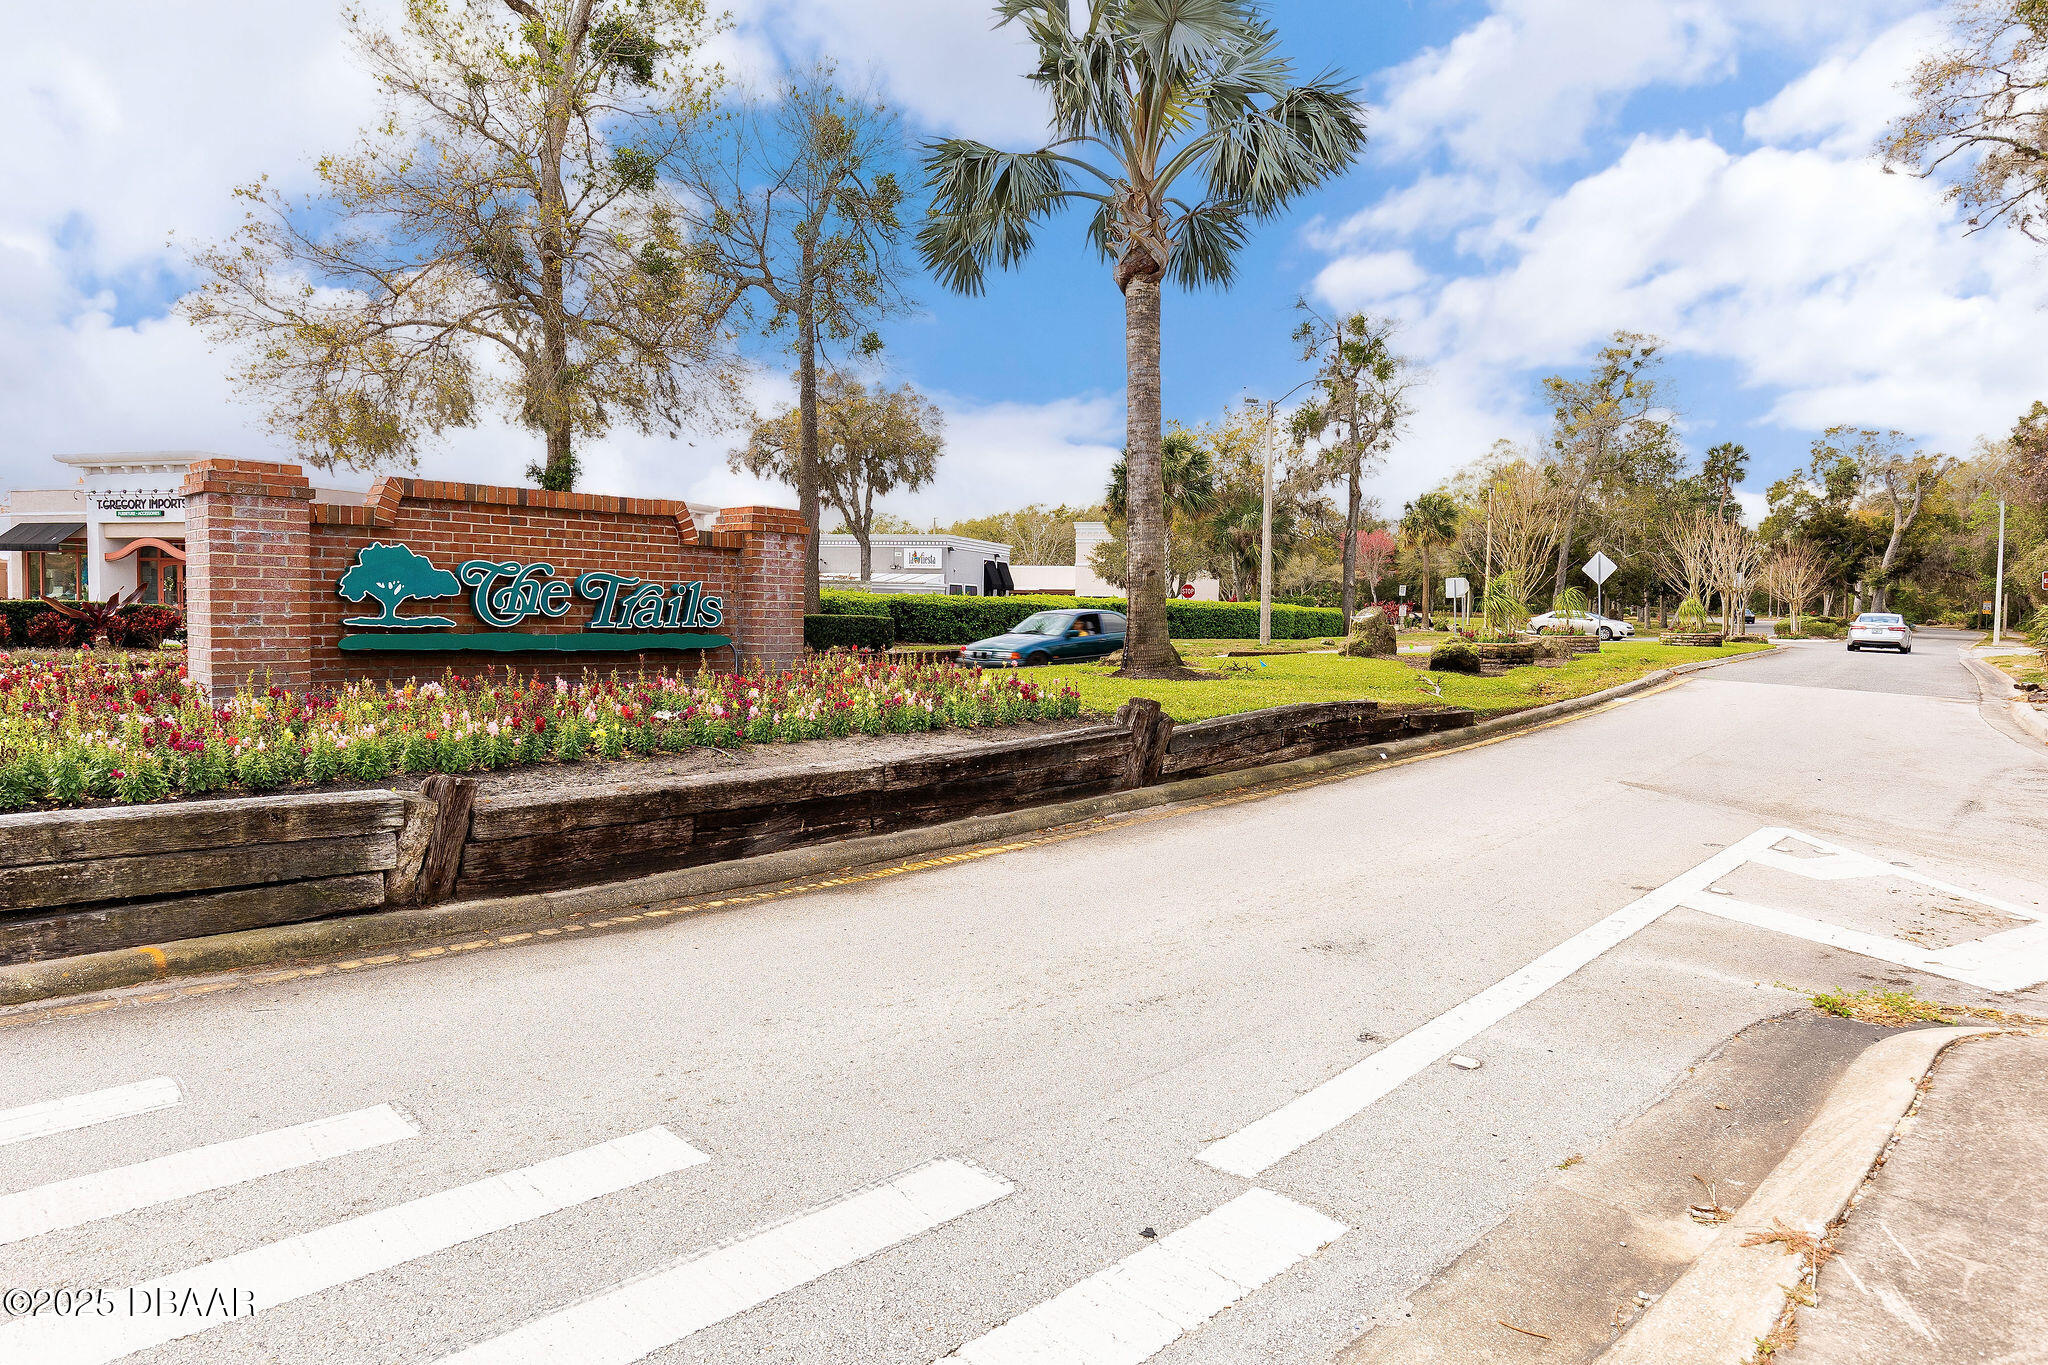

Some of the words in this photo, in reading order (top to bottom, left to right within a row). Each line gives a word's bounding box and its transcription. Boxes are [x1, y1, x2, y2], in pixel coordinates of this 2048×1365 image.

[97, 499, 146, 510] T.GREGORY
[148, 499, 185, 509] IMPORTS
[457, 560, 571, 628] The
[575, 572, 723, 629] Trails
